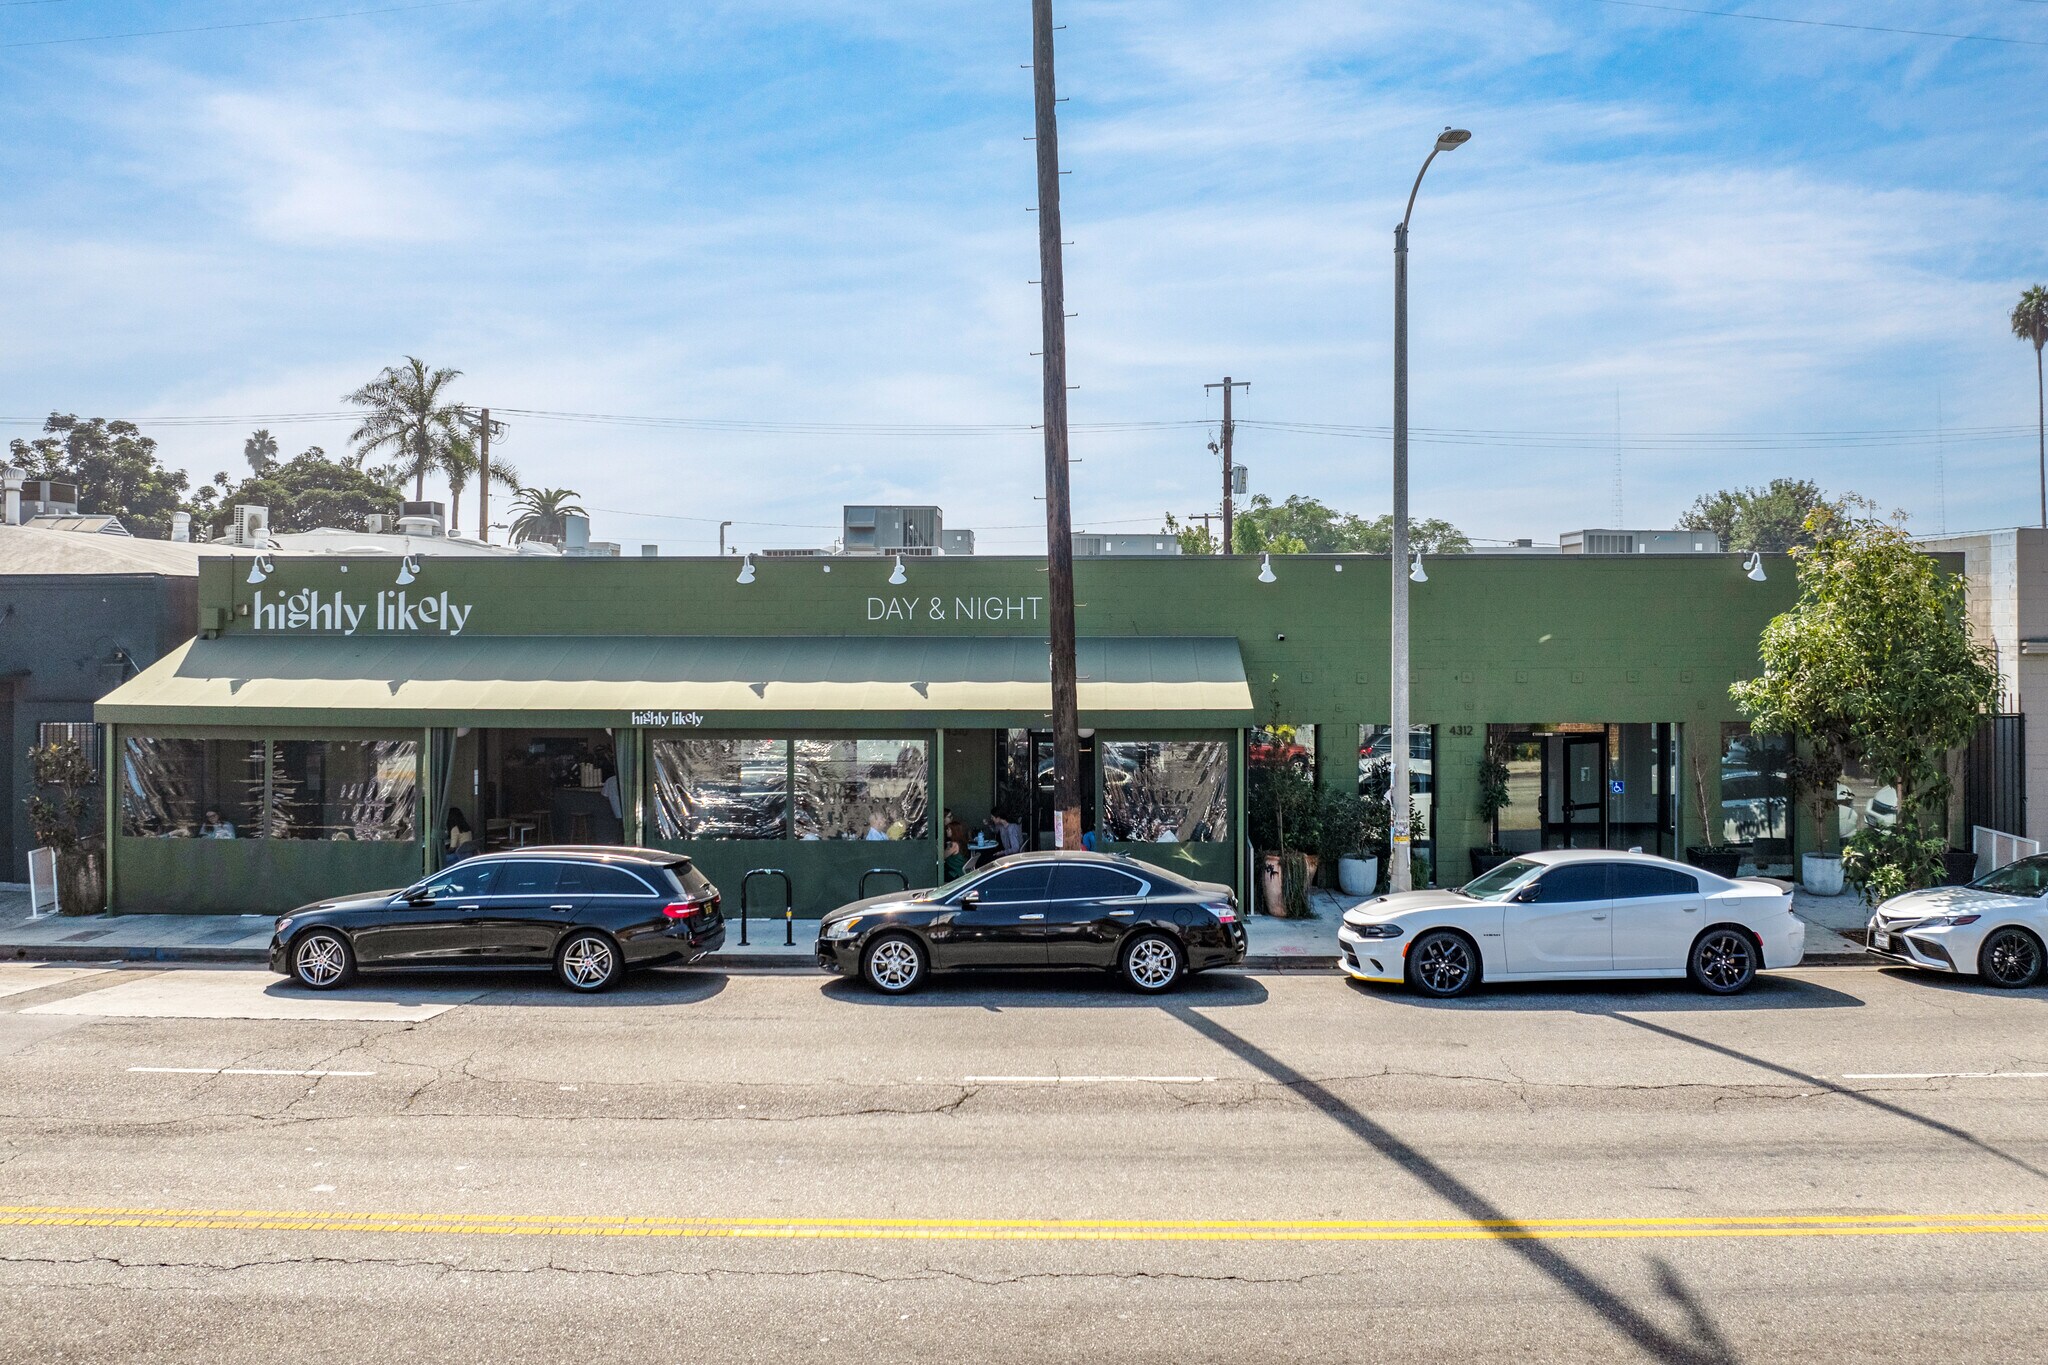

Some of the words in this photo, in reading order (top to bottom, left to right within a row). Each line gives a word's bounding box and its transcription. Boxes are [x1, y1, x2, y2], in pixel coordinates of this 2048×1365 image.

[254, 588, 367, 635] highly
[377, 590, 473, 636] likely
[867, 597, 920, 620] DAY
[929, 596, 946, 620] &
[955, 596, 1043, 620] NIGHT
[631, 710, 670, 727] highly
[671, 711, 704, 727] likely
[1447, 724, 1473, 736] 4312
